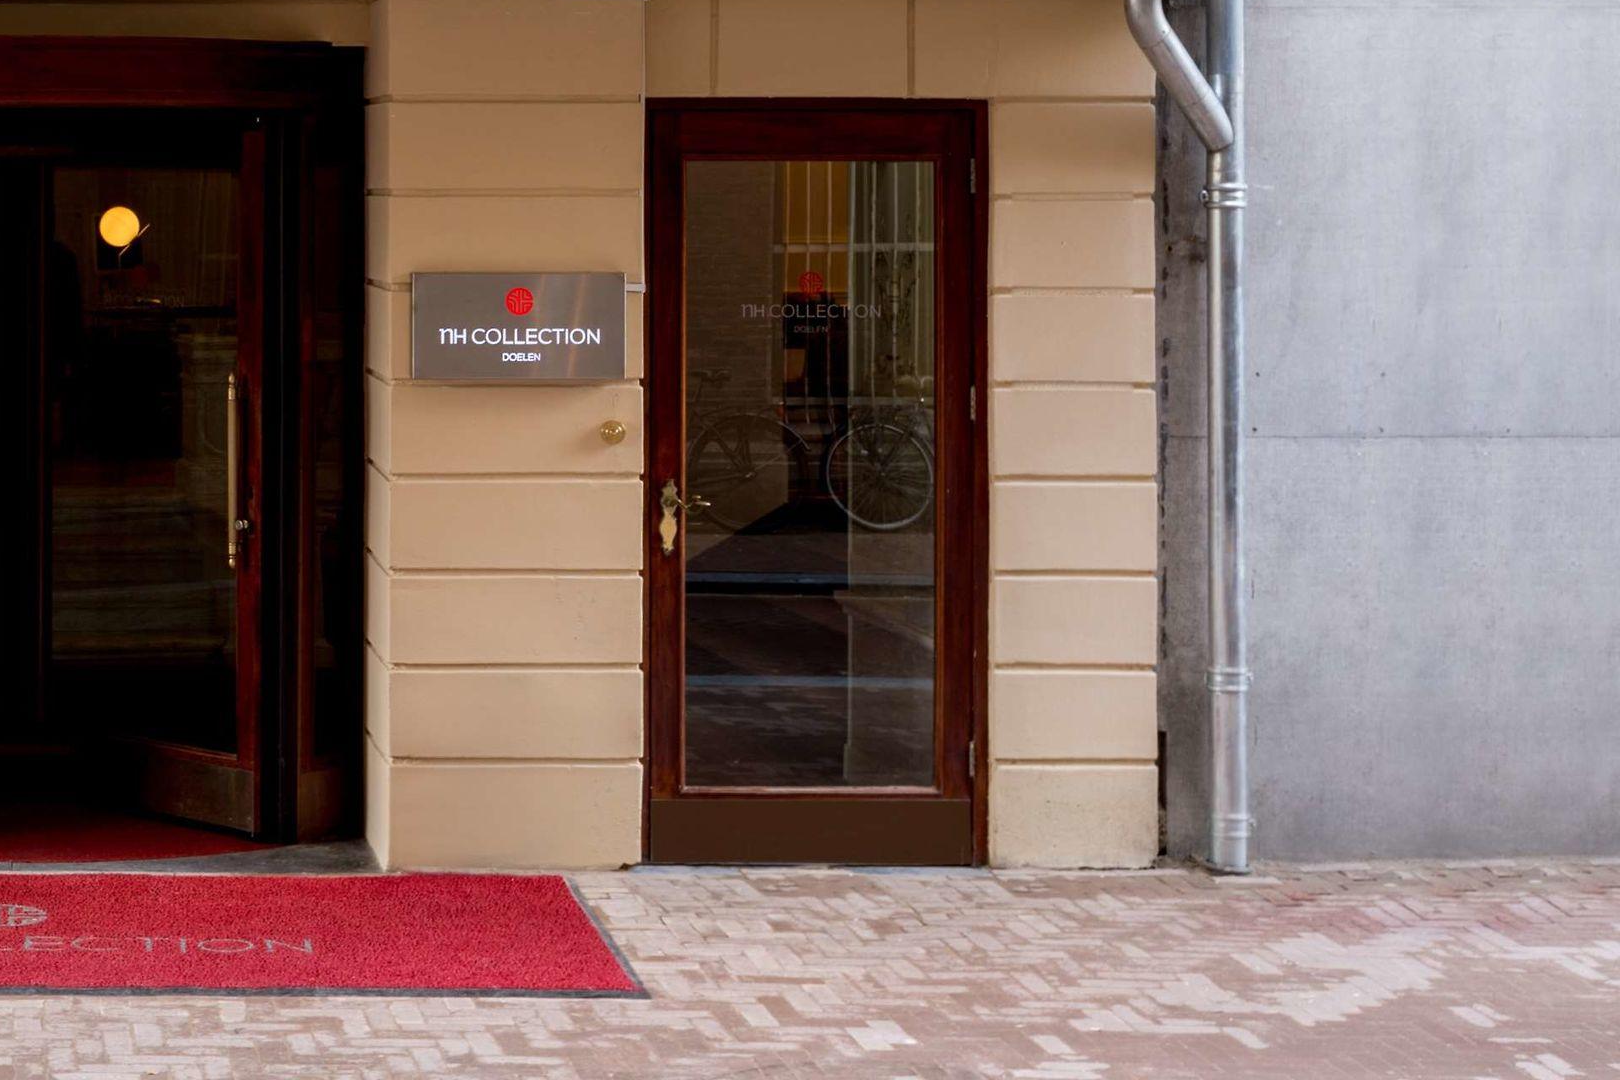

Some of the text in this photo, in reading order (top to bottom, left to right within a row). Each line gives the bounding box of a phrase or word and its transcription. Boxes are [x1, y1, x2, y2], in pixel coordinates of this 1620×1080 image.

[769, 303, 882, 319] COLLECTON
[471, 327, 601, 345] COLLECTION
[502, 352, 541, 362] DOELEN
